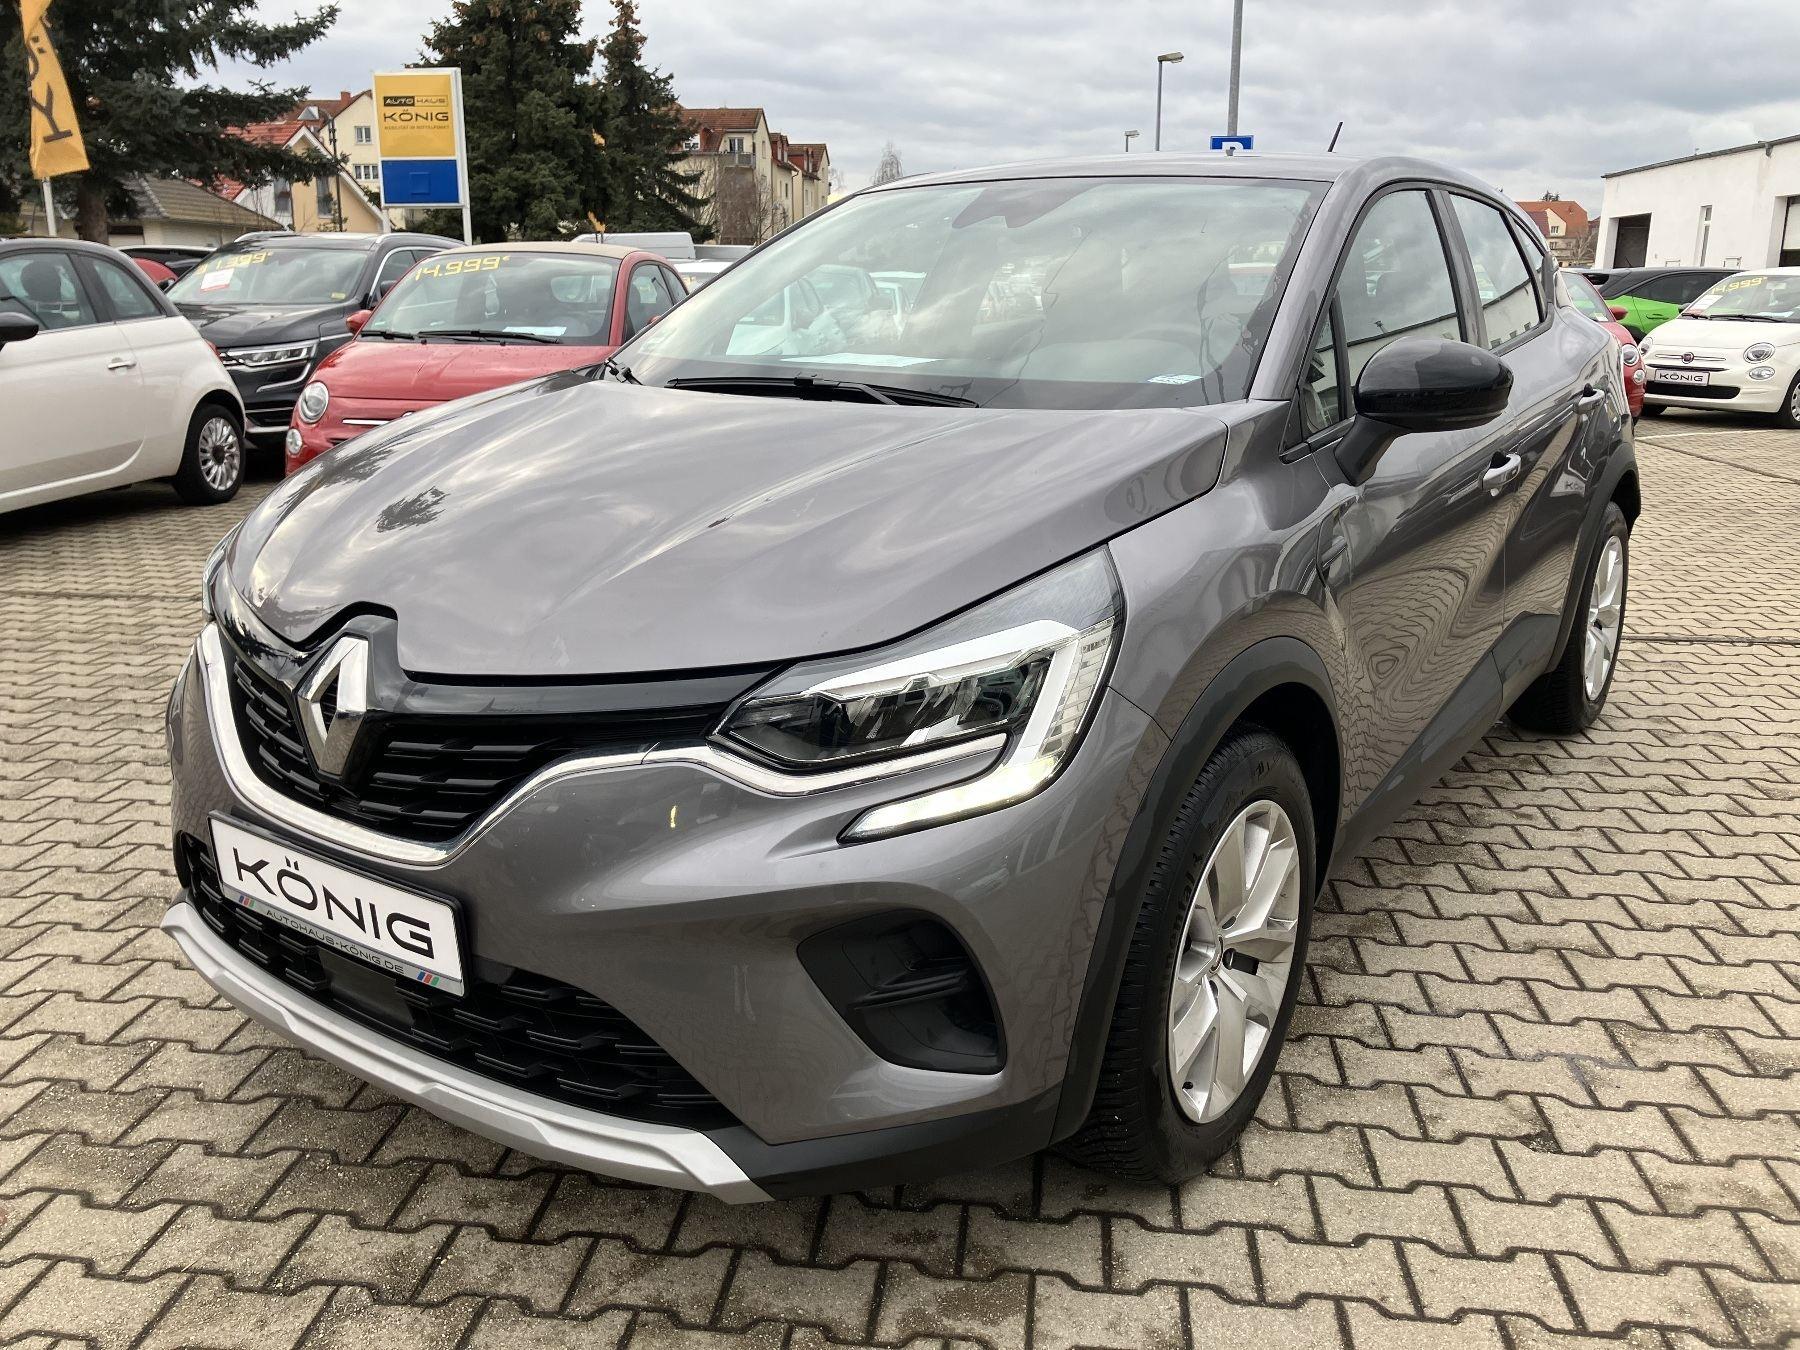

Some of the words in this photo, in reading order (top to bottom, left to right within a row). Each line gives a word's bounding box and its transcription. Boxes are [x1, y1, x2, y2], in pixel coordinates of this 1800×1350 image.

[384, 97, 414, 105] AUTO
[383, 108, 449, 122] KÖNIG
[1659, 372, 1704, 382] KÖNIG
[232, 846, 435, 960] KÖNIG
[266, 909, 404, 975] AUTOHAUS-KÖNIG.DE
